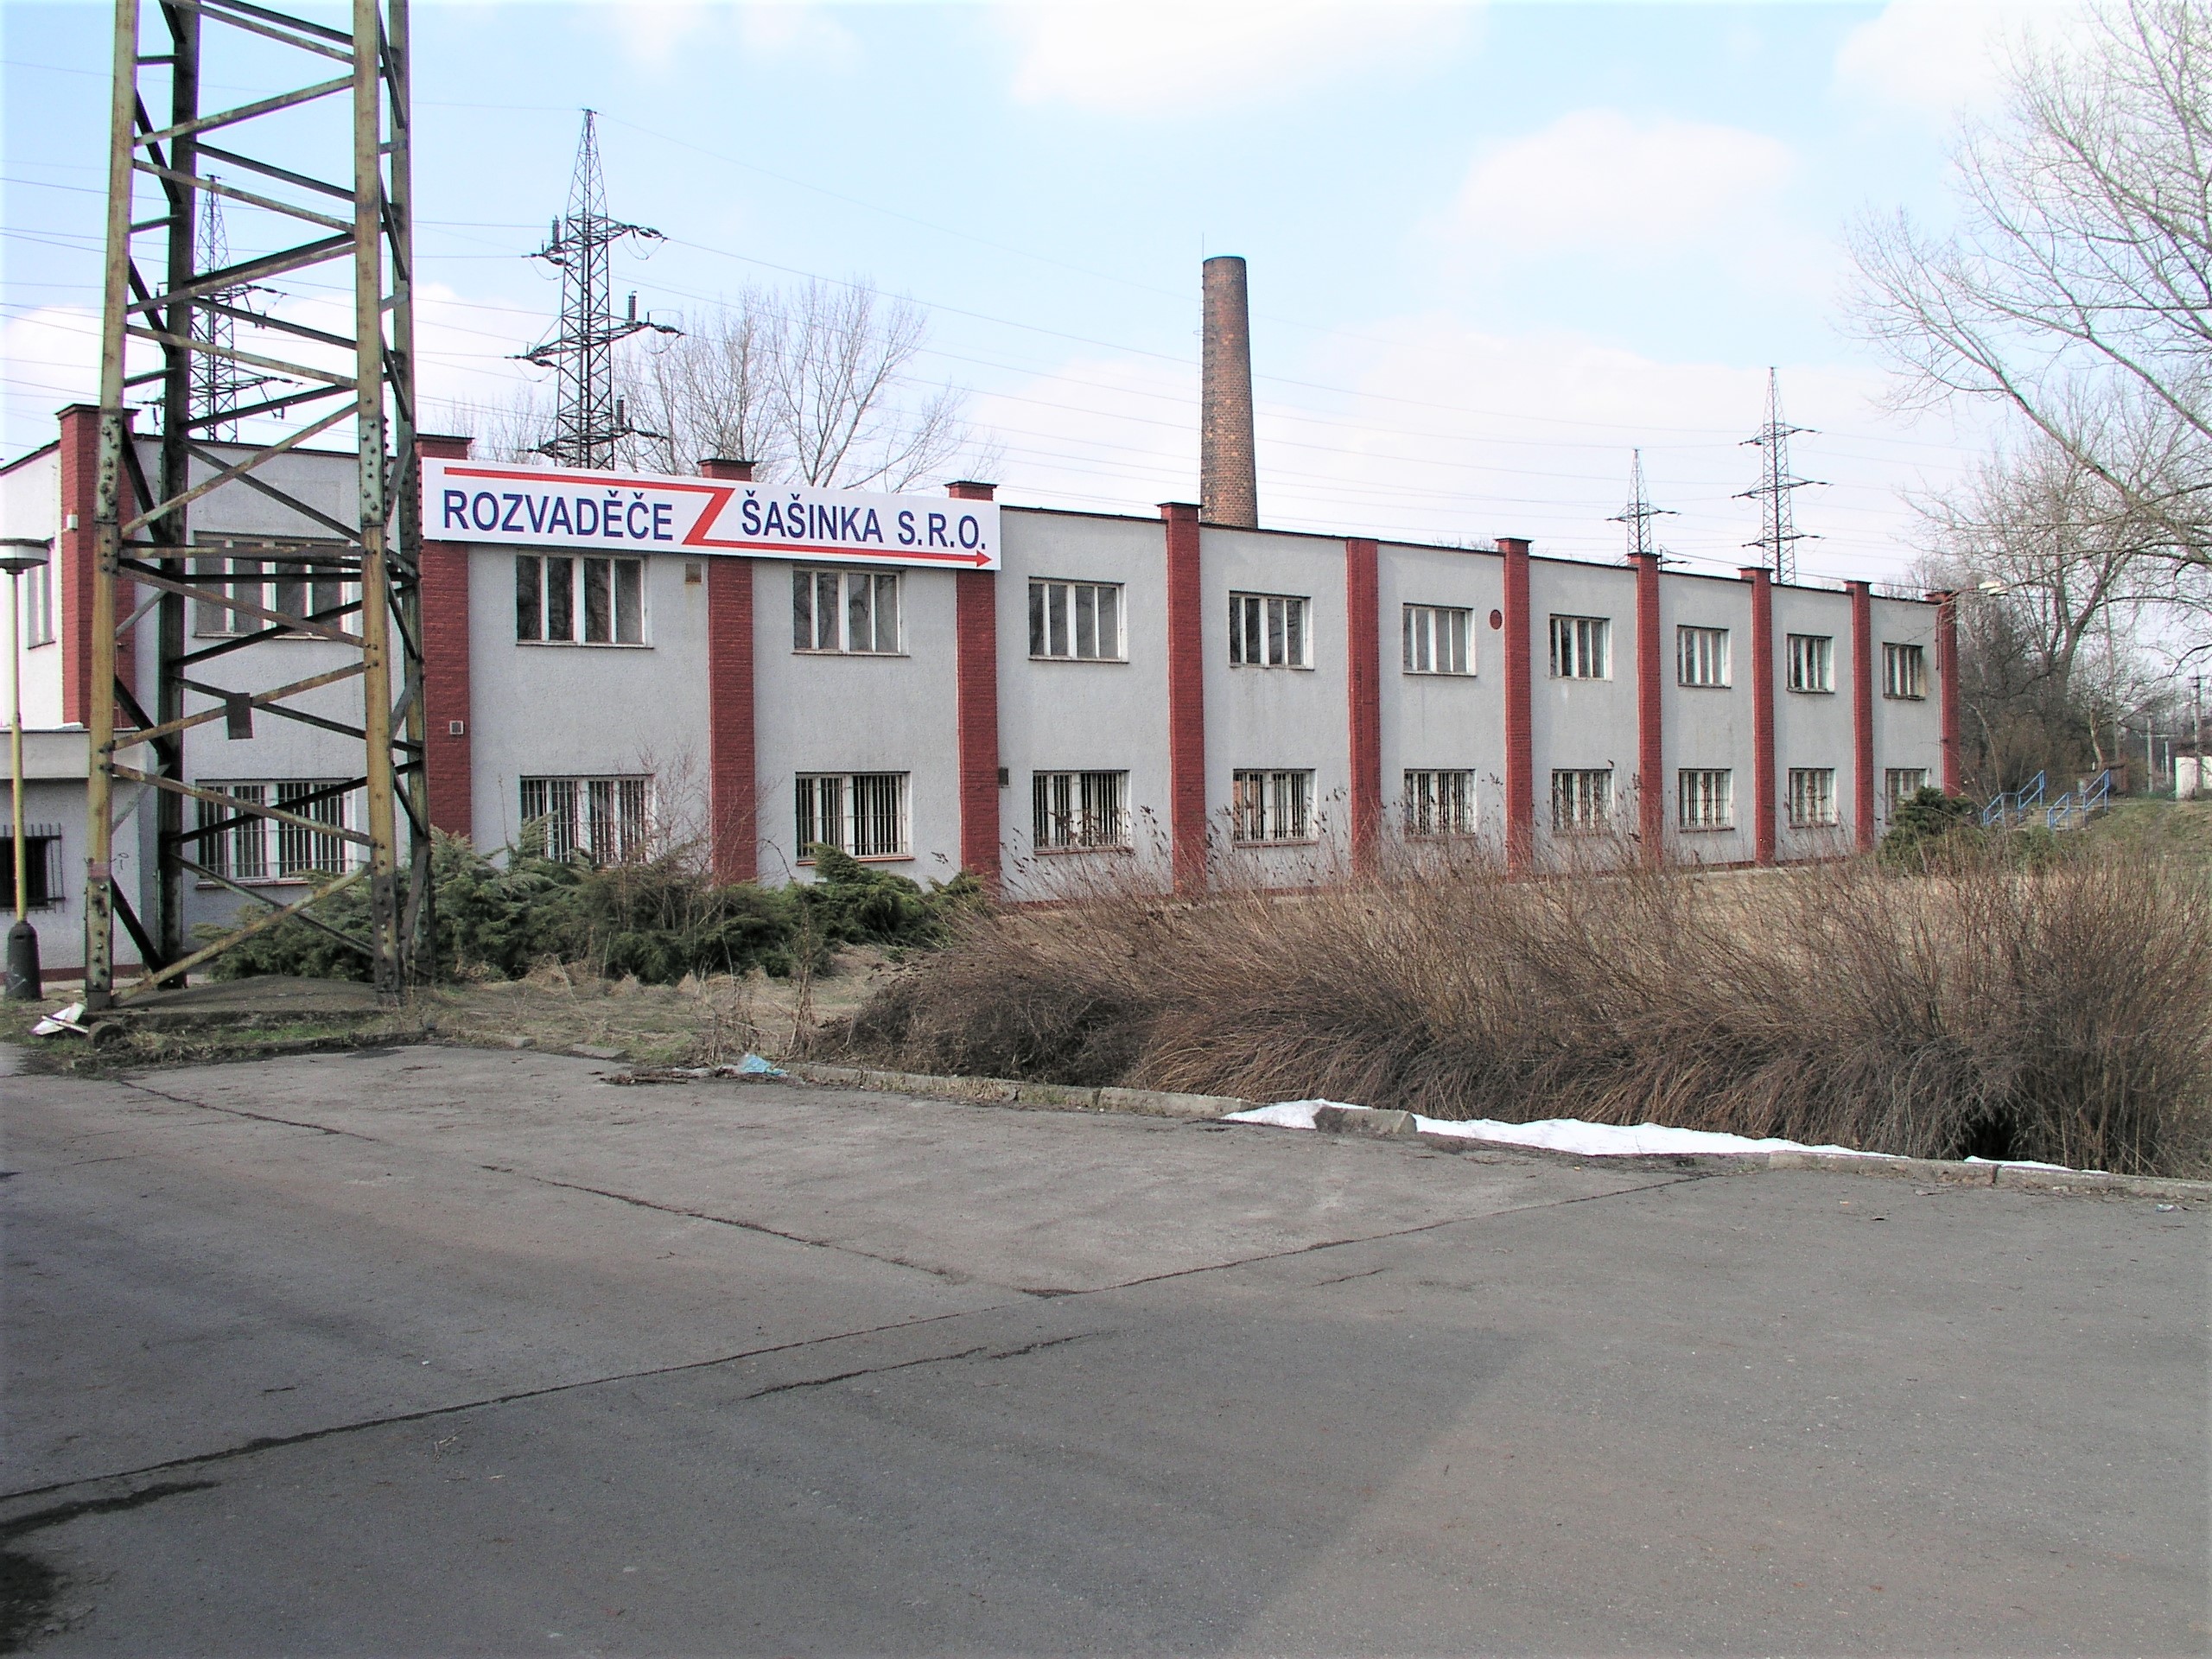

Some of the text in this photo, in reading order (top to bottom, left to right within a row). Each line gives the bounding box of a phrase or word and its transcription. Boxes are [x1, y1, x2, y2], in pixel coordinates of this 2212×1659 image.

[443, 489, 987, 550] ROZVADĚČE ŠAŠINKA S.R.O.
